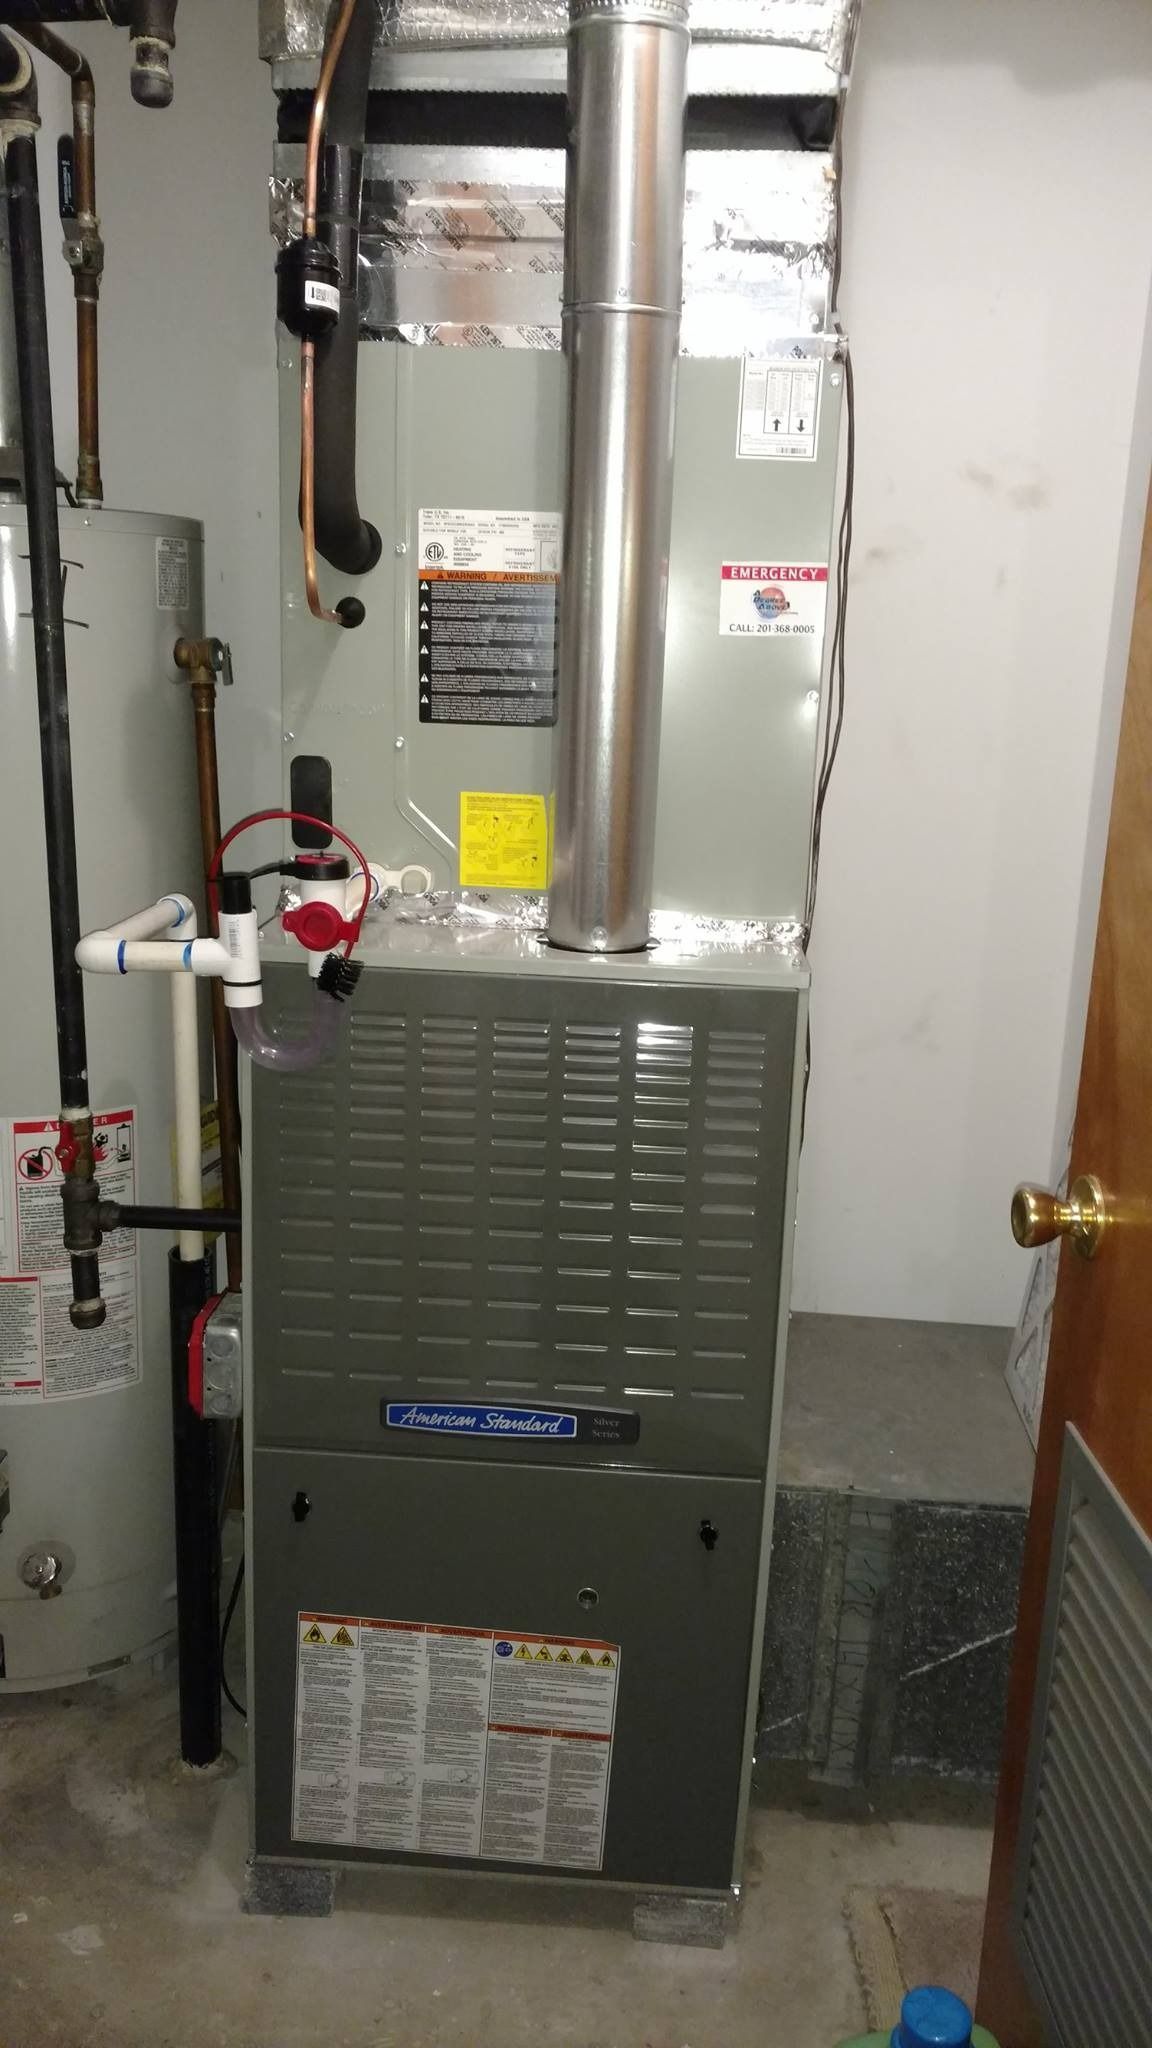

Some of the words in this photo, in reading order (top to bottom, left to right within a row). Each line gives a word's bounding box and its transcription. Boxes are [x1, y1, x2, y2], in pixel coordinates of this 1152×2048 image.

[447, 571, 487, 580] WARNING
[730, 567, 819, 580] EMERGENCY
[729, 623, 755, 633] CALL:
[756, 624, 815, 634] 201-368-0005
[400, 1406, 477, 1427] American
[480, 1413, 563, 1434] Standard
